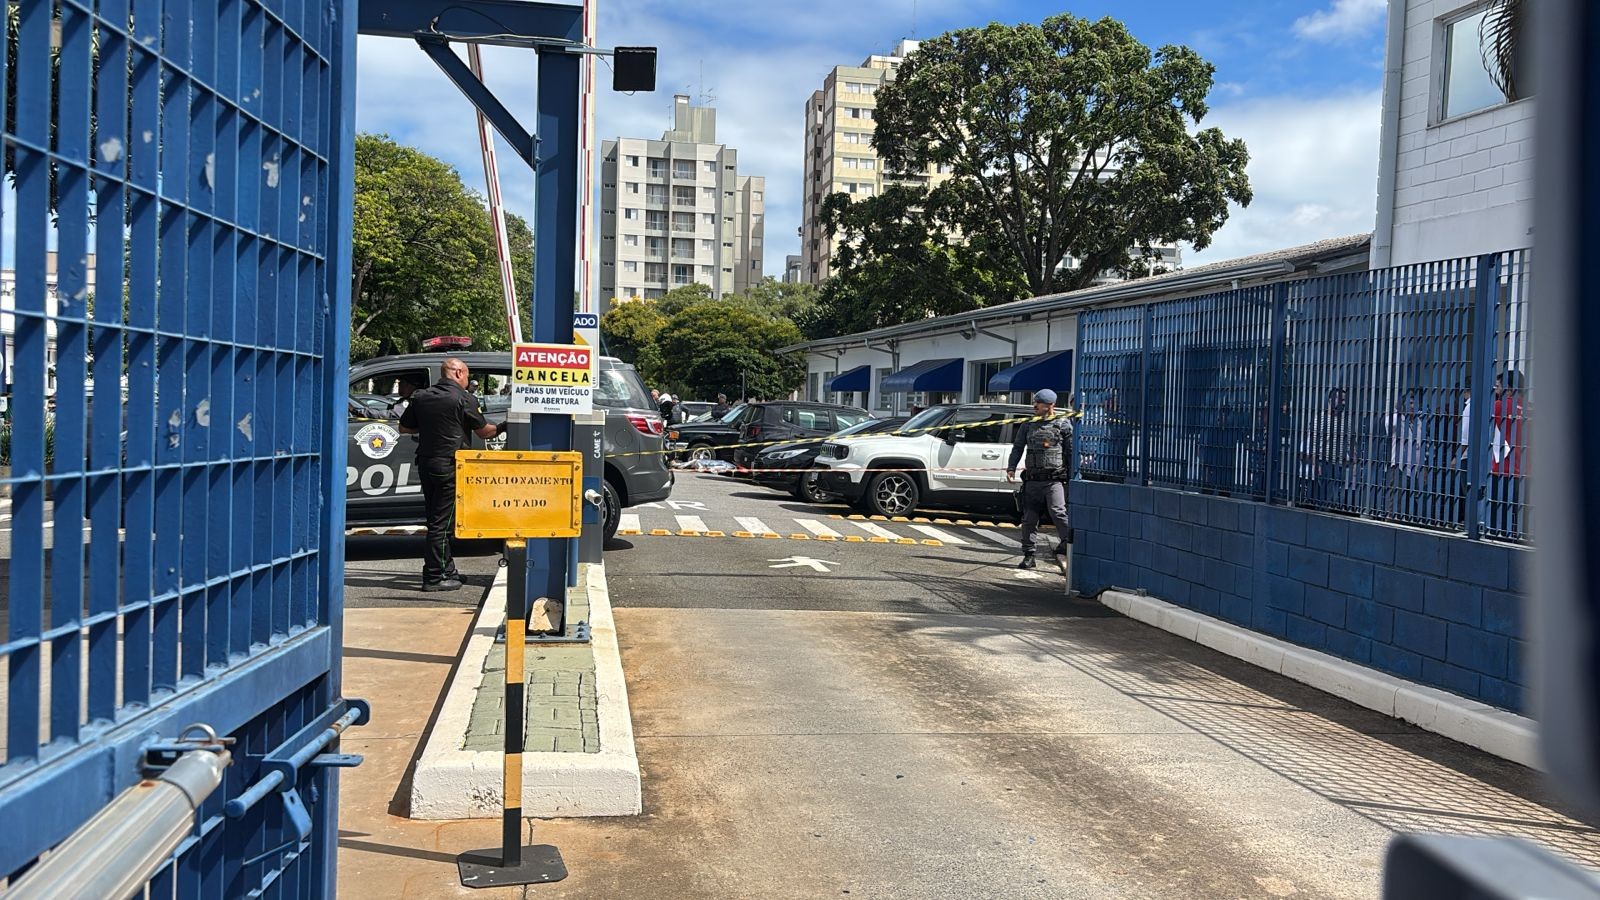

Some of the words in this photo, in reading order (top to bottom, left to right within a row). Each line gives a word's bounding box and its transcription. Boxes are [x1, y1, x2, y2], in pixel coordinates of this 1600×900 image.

[518, 351, 588, 366] ATENÇÃO
[515, 370, 590, 383] CANCELA
[515, 386, 544, 395] APENAS
[558, 387, 590, 396] VEÍCULO
[524, 396, 540, 404] POR
[541, 397, 580, 405] ABERTURA
[466, 475, 574, 486] ESTACIONAMENTO
[492, 499, 547, 508] LOTADO
